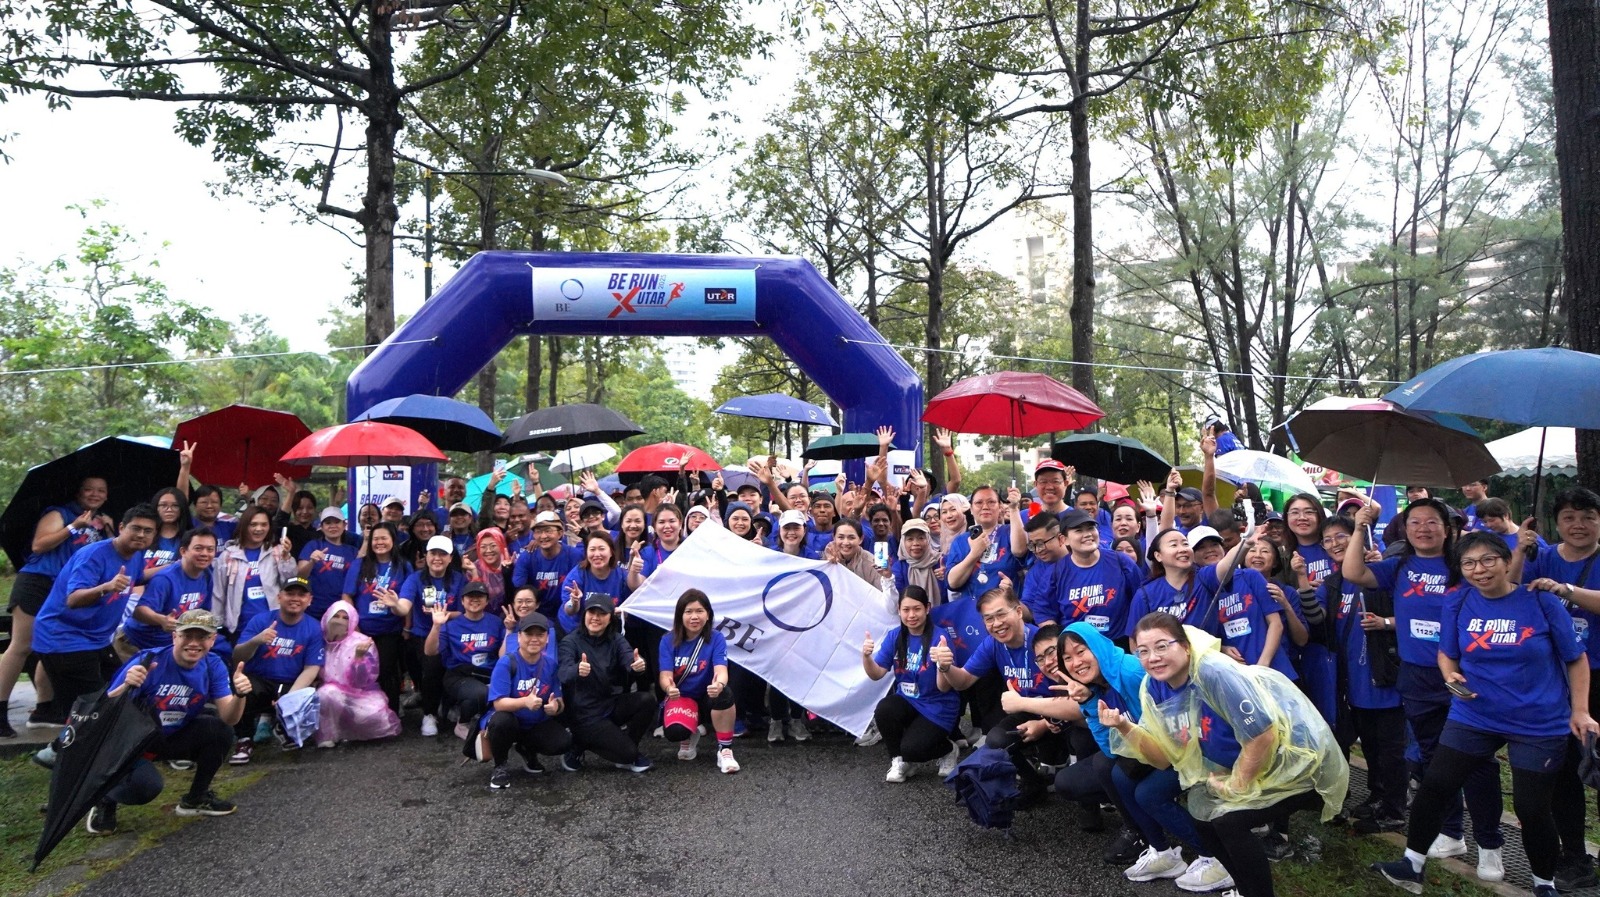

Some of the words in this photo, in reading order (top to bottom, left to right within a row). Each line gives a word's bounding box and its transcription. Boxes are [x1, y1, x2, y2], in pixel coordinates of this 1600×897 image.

[607, 273, 628, 290] BE
[629, 273, 660, 290] RUN
[637, 291, 666, 305] UTAR
[555, 303, 571, 312] BE
[528, 426, 562, 436] SIEMENS
[1303, 465, 1324, 476] MILO
[1308, 559, 1325, 573] RUN
[1408, 570, 1421, 582] BE
[1419, 572, 1441, 584] RUN
[1069, 587, 1081, 601] BE
[1080, 584, 1099, 599] RUN
[1424, 584, 1446, 594] UTAR
[1087, 595, 1105, 607] UTAR
[1218, 593, 1236, 611] RUN
[1225, 602, 1243, 616] UTAR
[1466, 618, 1484, 632] BE
[1483, 618, 1510, 633] RUN
[460, 633, 470, 643] BE
[714, 616, 765, 653] BE
[1415, 628, 1434, 637] 1125
[1490, 632, 1518, 644] UTAR
[1018, 679, 1034, 688] UTAR
[167, 684, 189, 697] RUN
[169, 696, 190, 706] UTAR
[1243, 715, 1256, 726] BE
